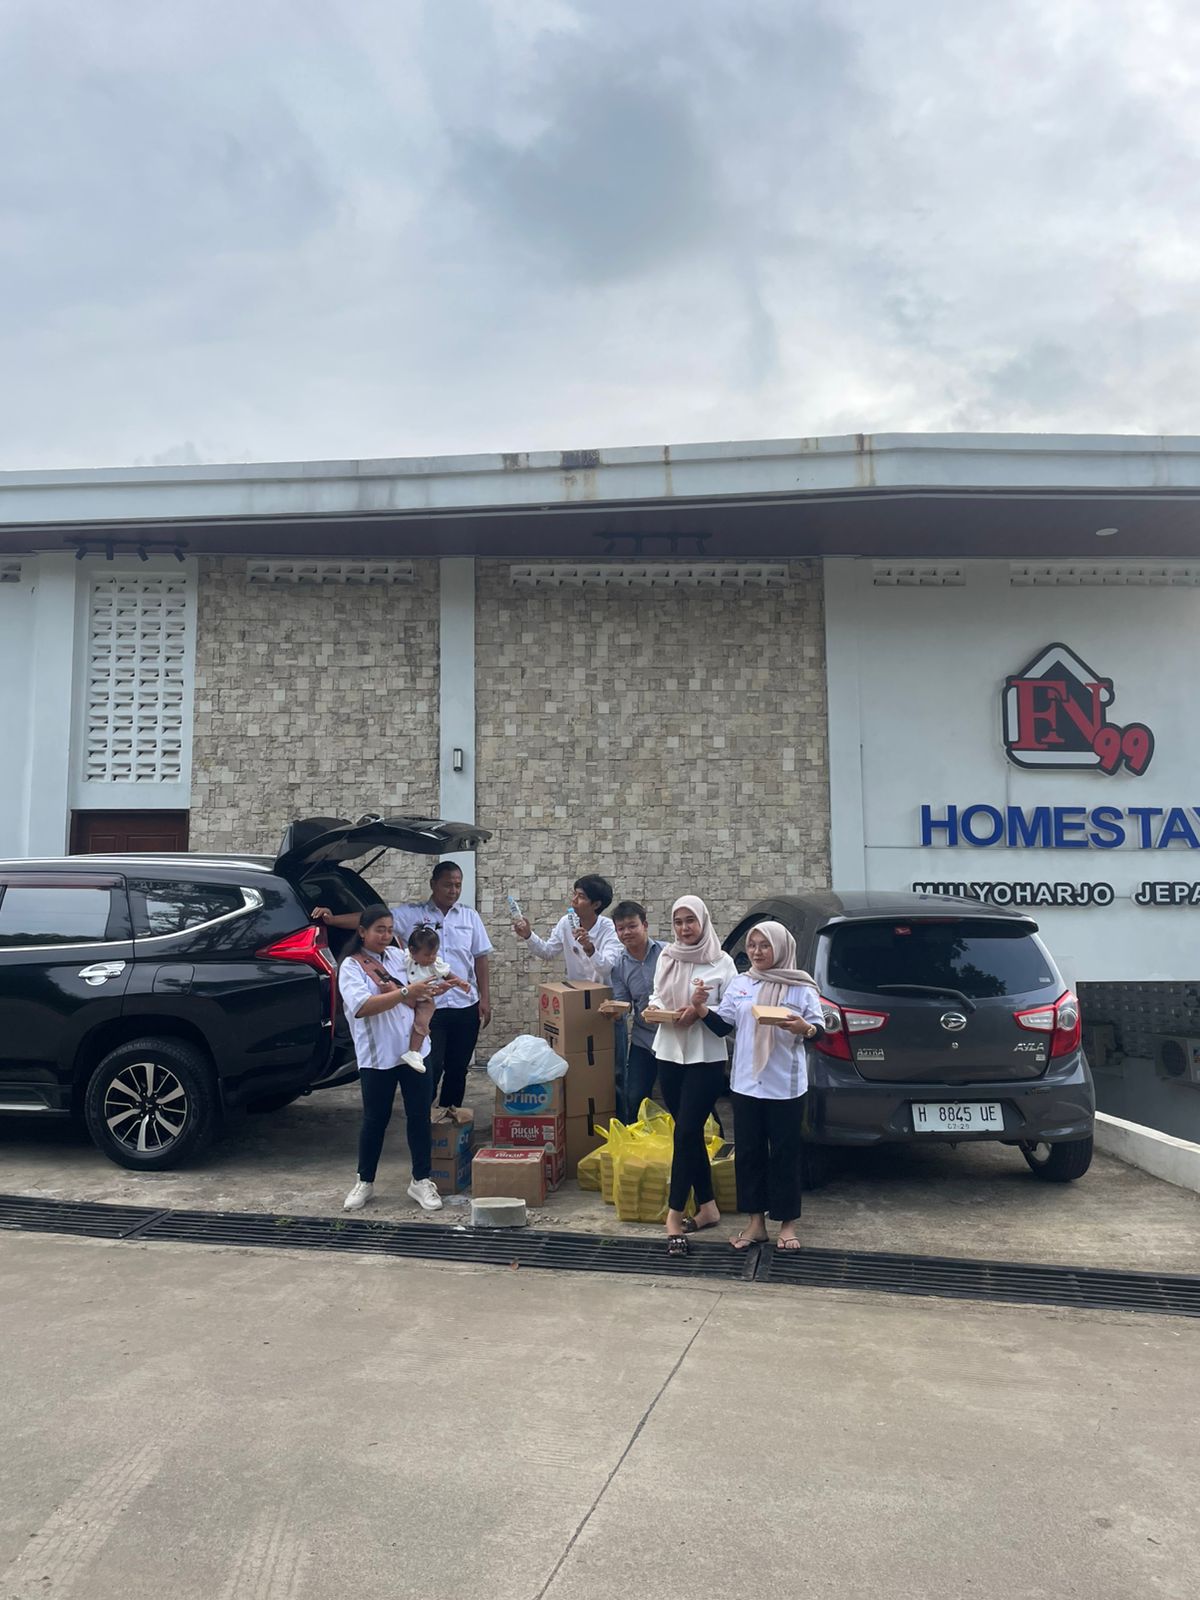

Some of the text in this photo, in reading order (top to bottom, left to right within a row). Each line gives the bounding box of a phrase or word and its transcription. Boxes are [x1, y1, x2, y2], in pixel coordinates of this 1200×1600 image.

[920, 803, 1200, 849] HOMESTA
[918, 1105, 997, 1122] H 8845 UE
[511, 1125, 540, 1138] pucuk
